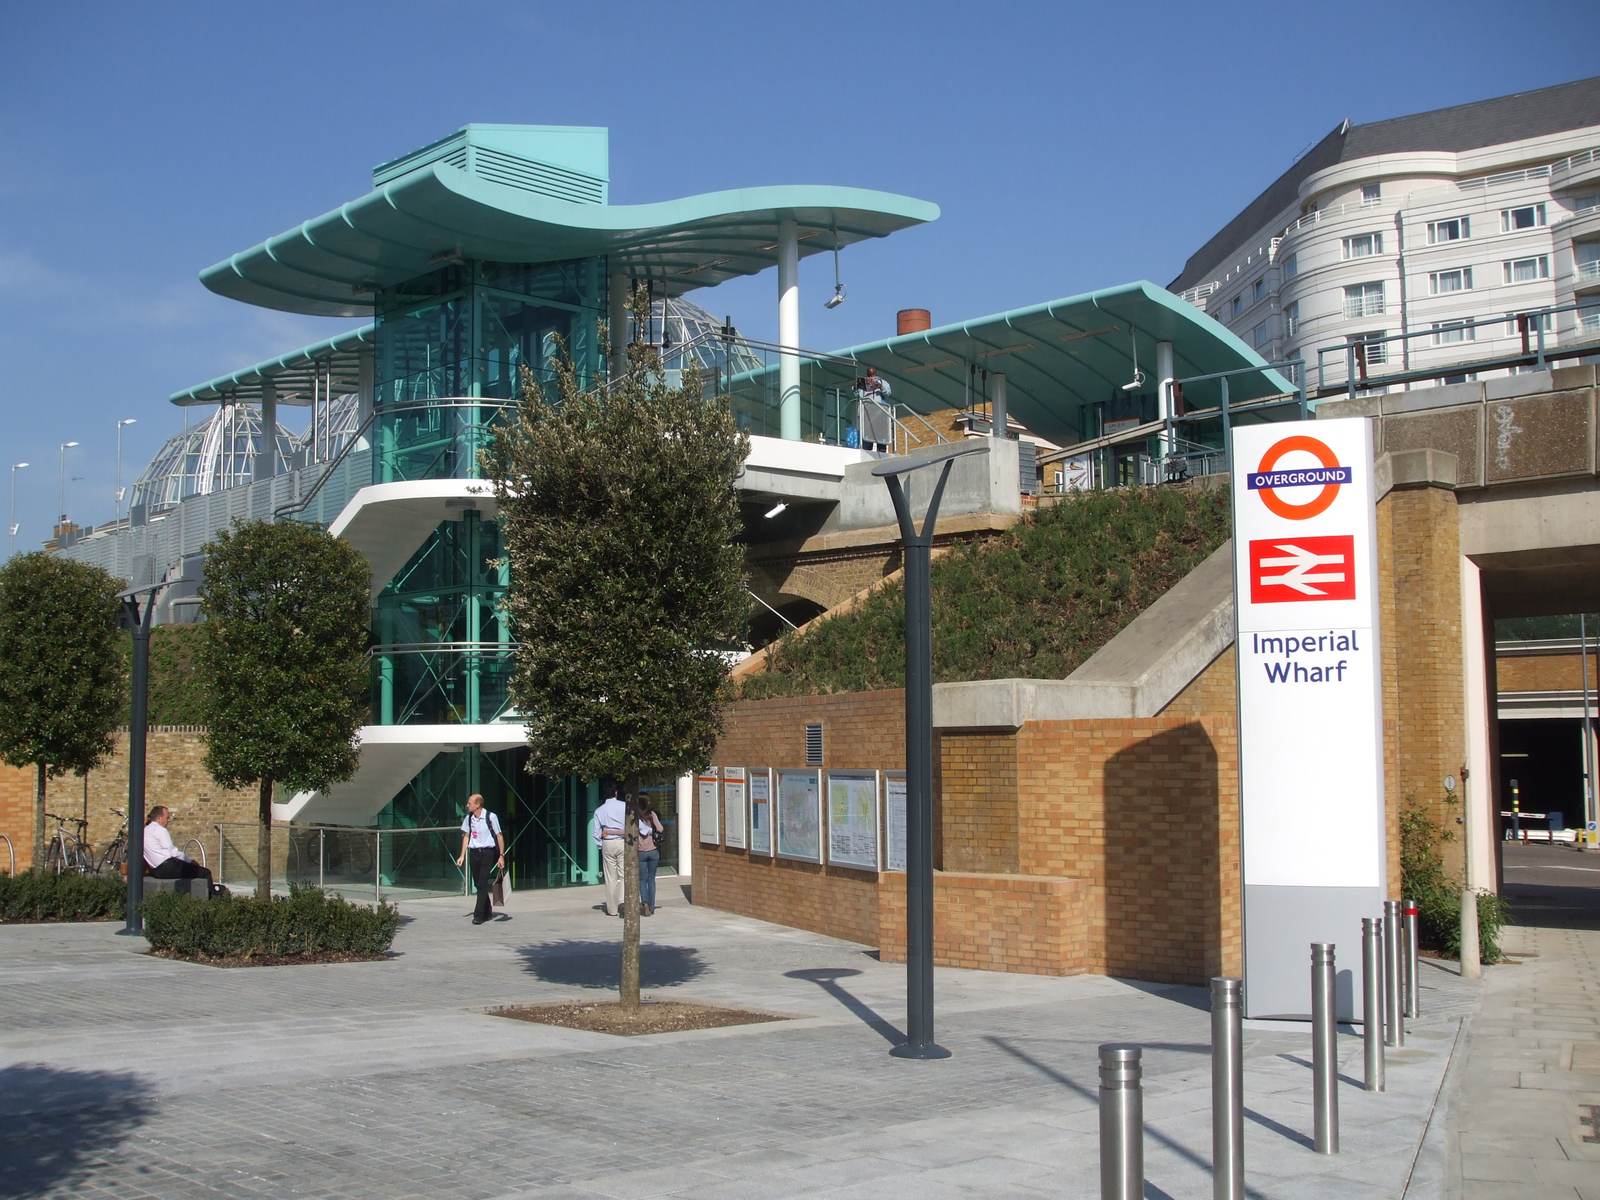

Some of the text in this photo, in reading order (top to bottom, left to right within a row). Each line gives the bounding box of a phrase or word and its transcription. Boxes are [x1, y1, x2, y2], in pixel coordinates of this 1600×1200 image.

[1255, 471, 1346, 487] OVERGROUND
[1253, 630, 1359, 658] Imperial
[1264, 660, 1348, 683] Wharf
